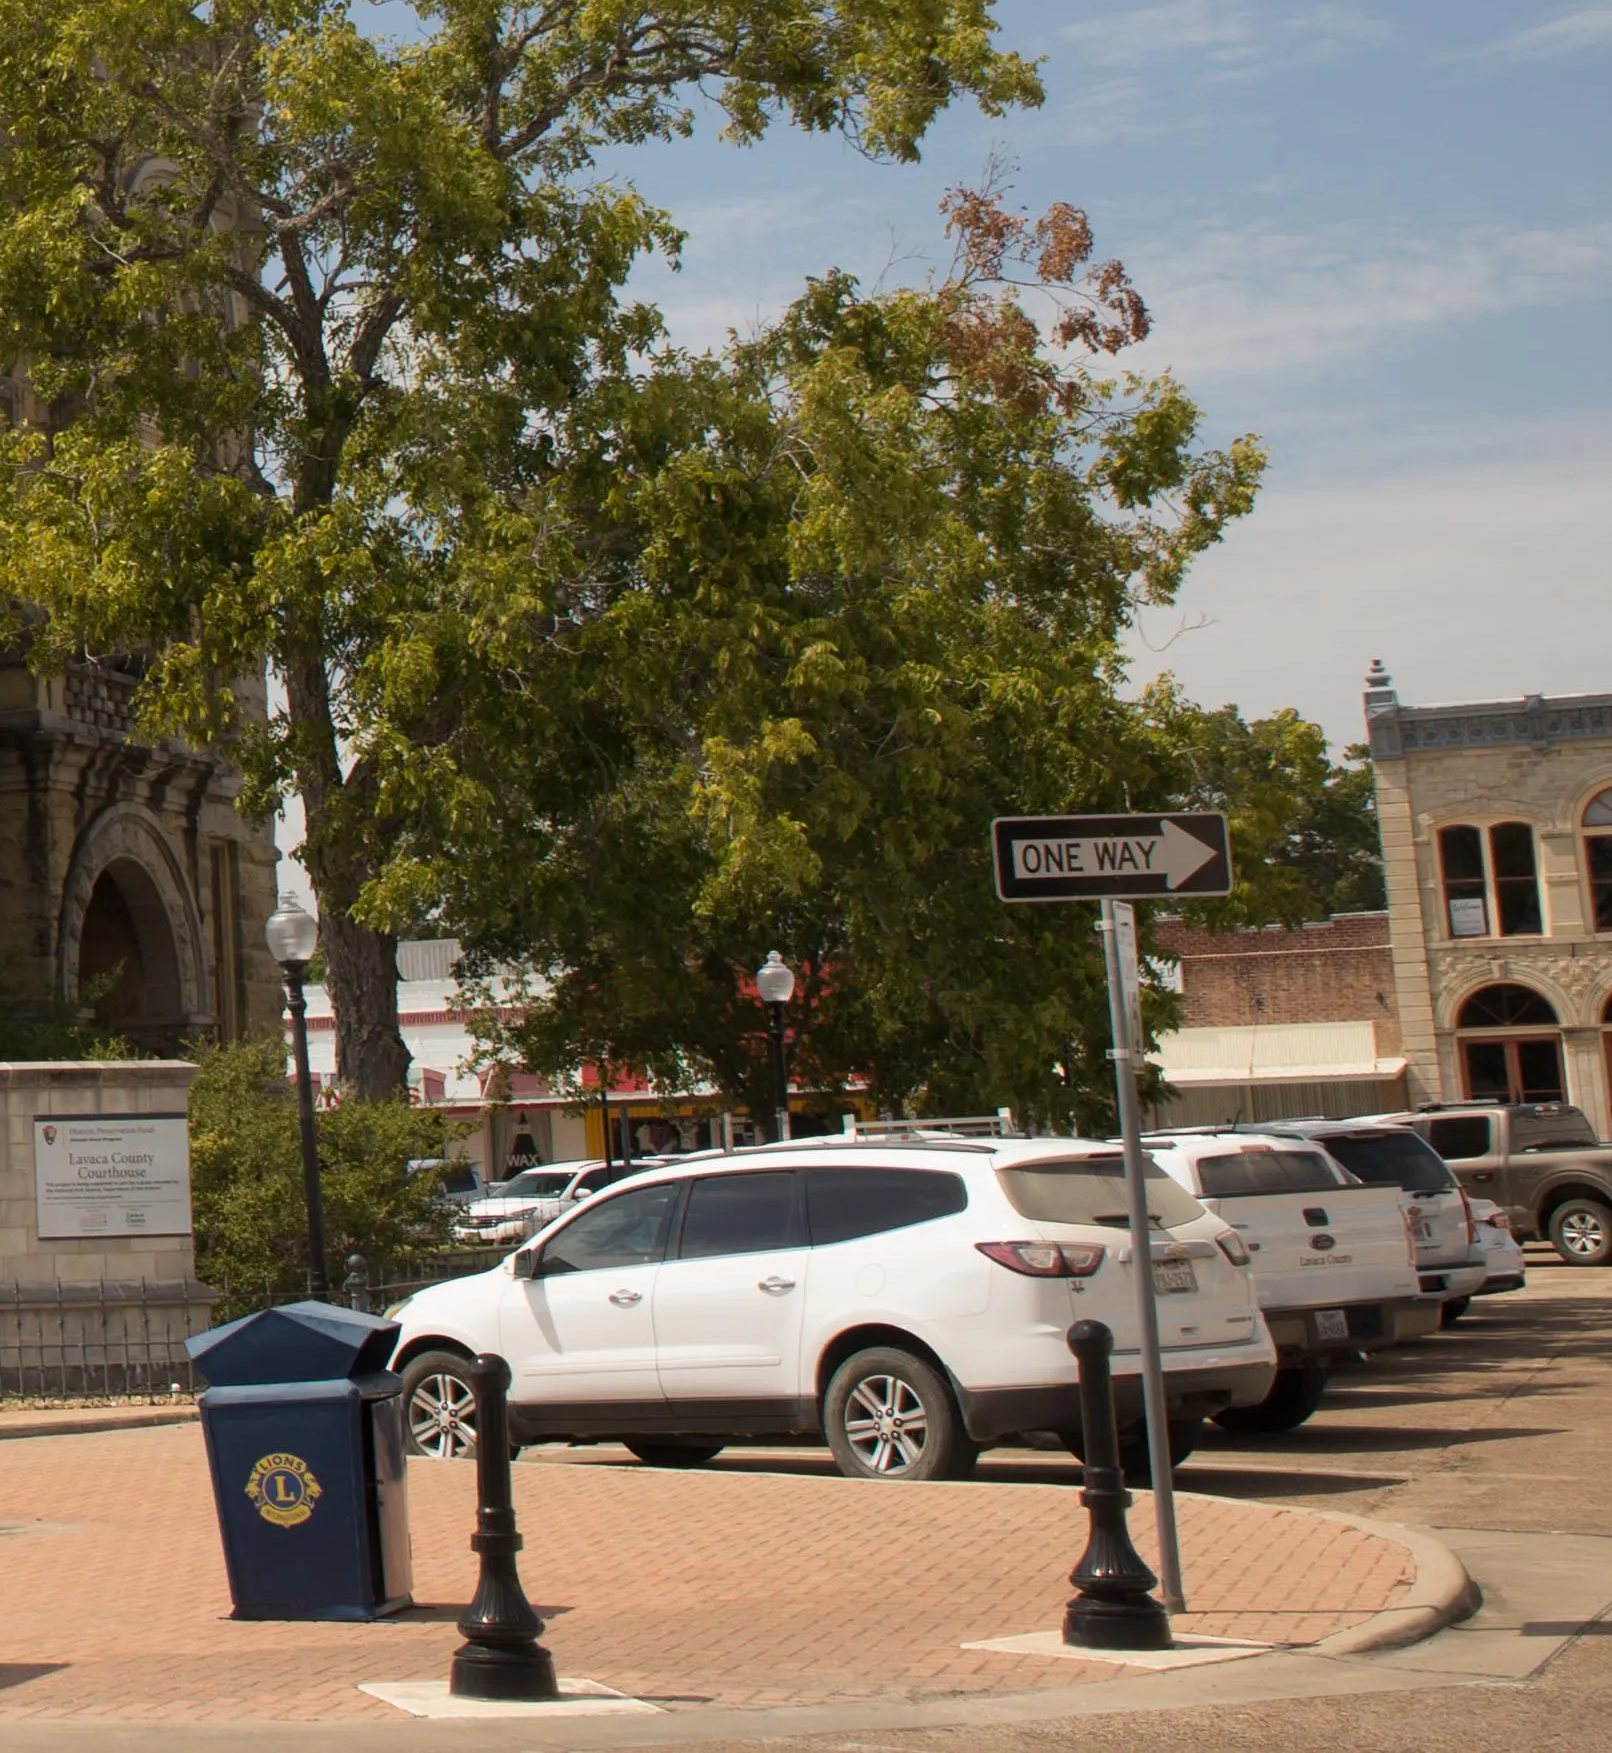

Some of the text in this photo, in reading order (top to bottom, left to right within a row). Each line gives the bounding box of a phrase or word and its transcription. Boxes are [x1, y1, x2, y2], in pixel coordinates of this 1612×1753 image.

[1023, 841, 1157, 873] ONE WAY
[68, 1152, 155, 1166] Lavaca County
[505, 1154, 539, 1167] WAX
[77, 1166, 147, 1179] Courthouse
[259, 1455, 303, 1471] LIONS
[274, 1476, 296, 1501] L
